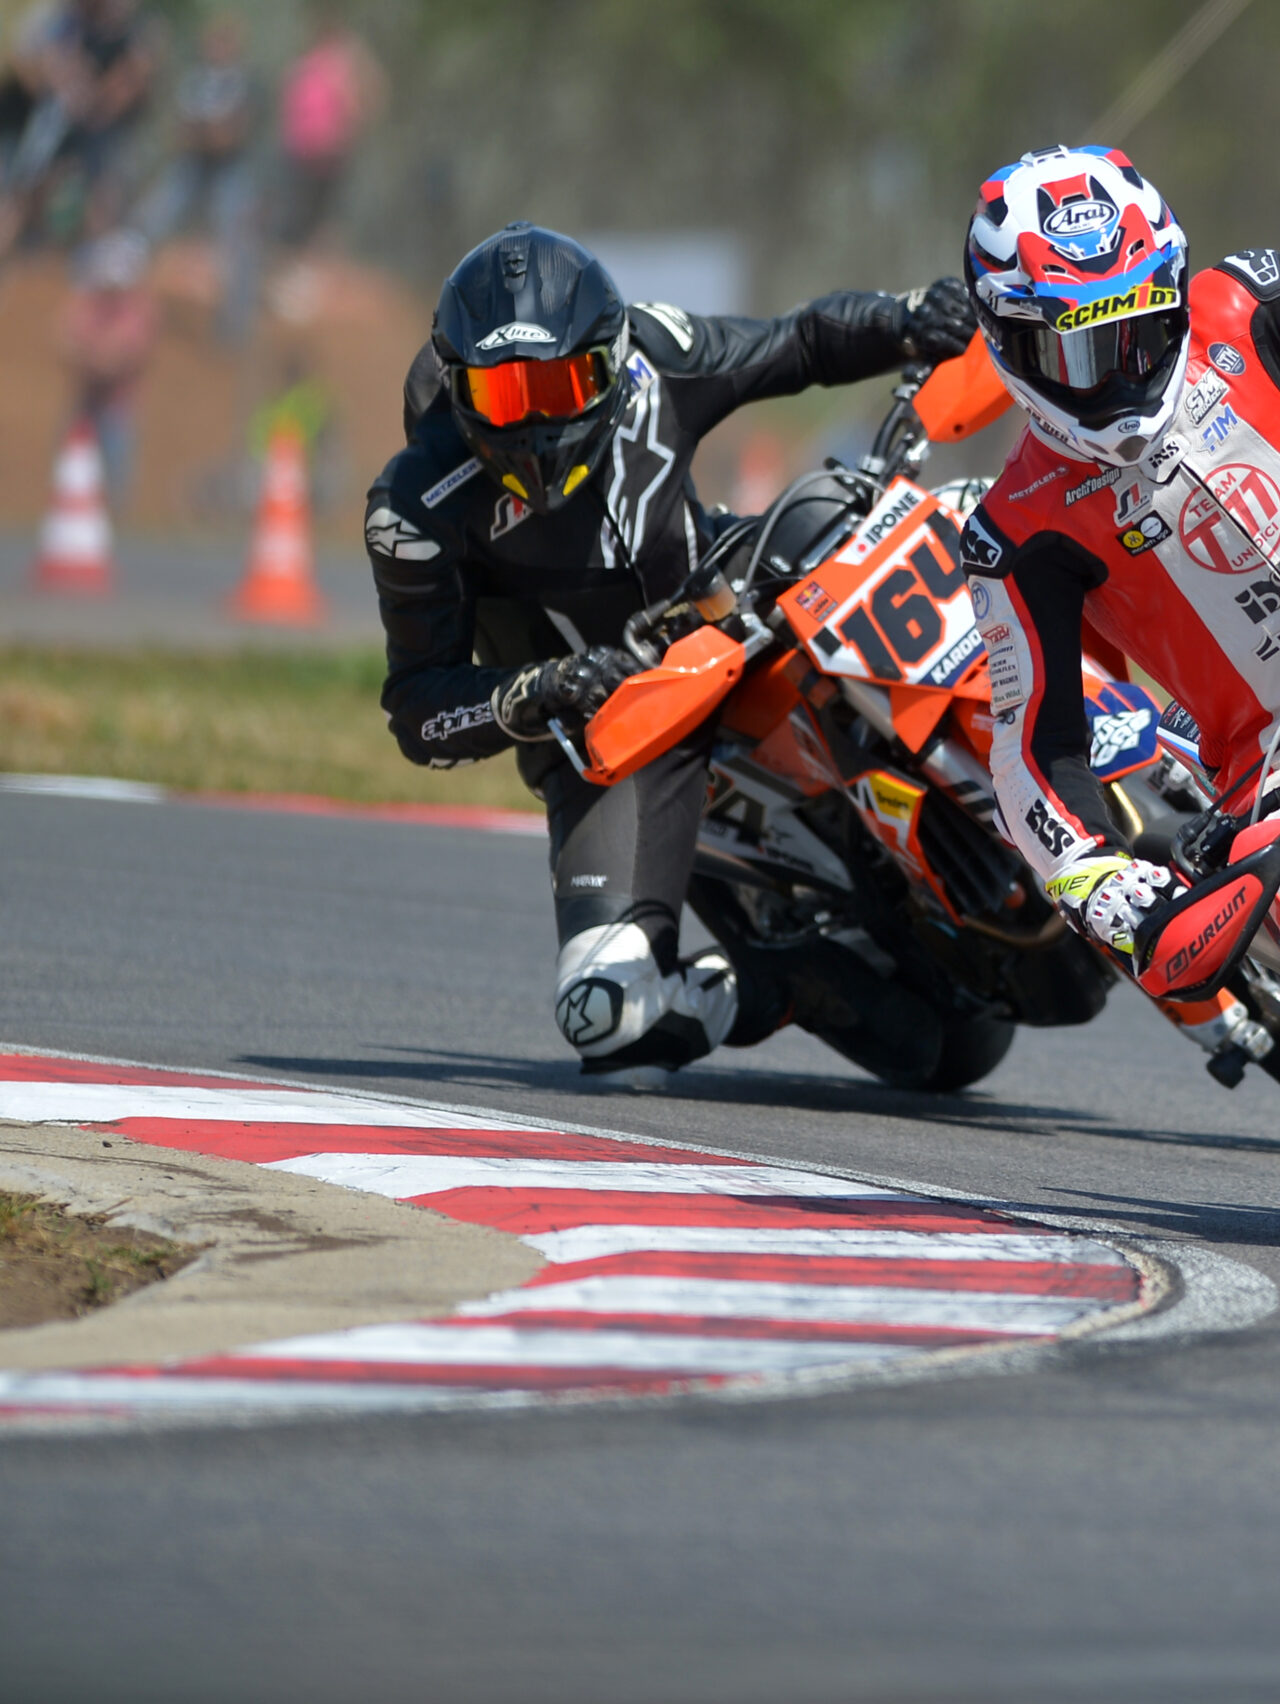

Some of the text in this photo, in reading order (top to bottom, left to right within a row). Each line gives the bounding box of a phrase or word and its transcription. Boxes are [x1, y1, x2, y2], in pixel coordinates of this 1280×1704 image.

[1051, 203, 1107, 232] Arai
[1216, 345, 1241, 371] STM
[425, 462, 479, 504] METZELER
[1008, 472, 1056, 501] METZELER
[1188, 471, 1237, 518] TEAM
[866, 491, 919, 546] IPONE
[1188, 886, 1247, 958] CIRCUIT
